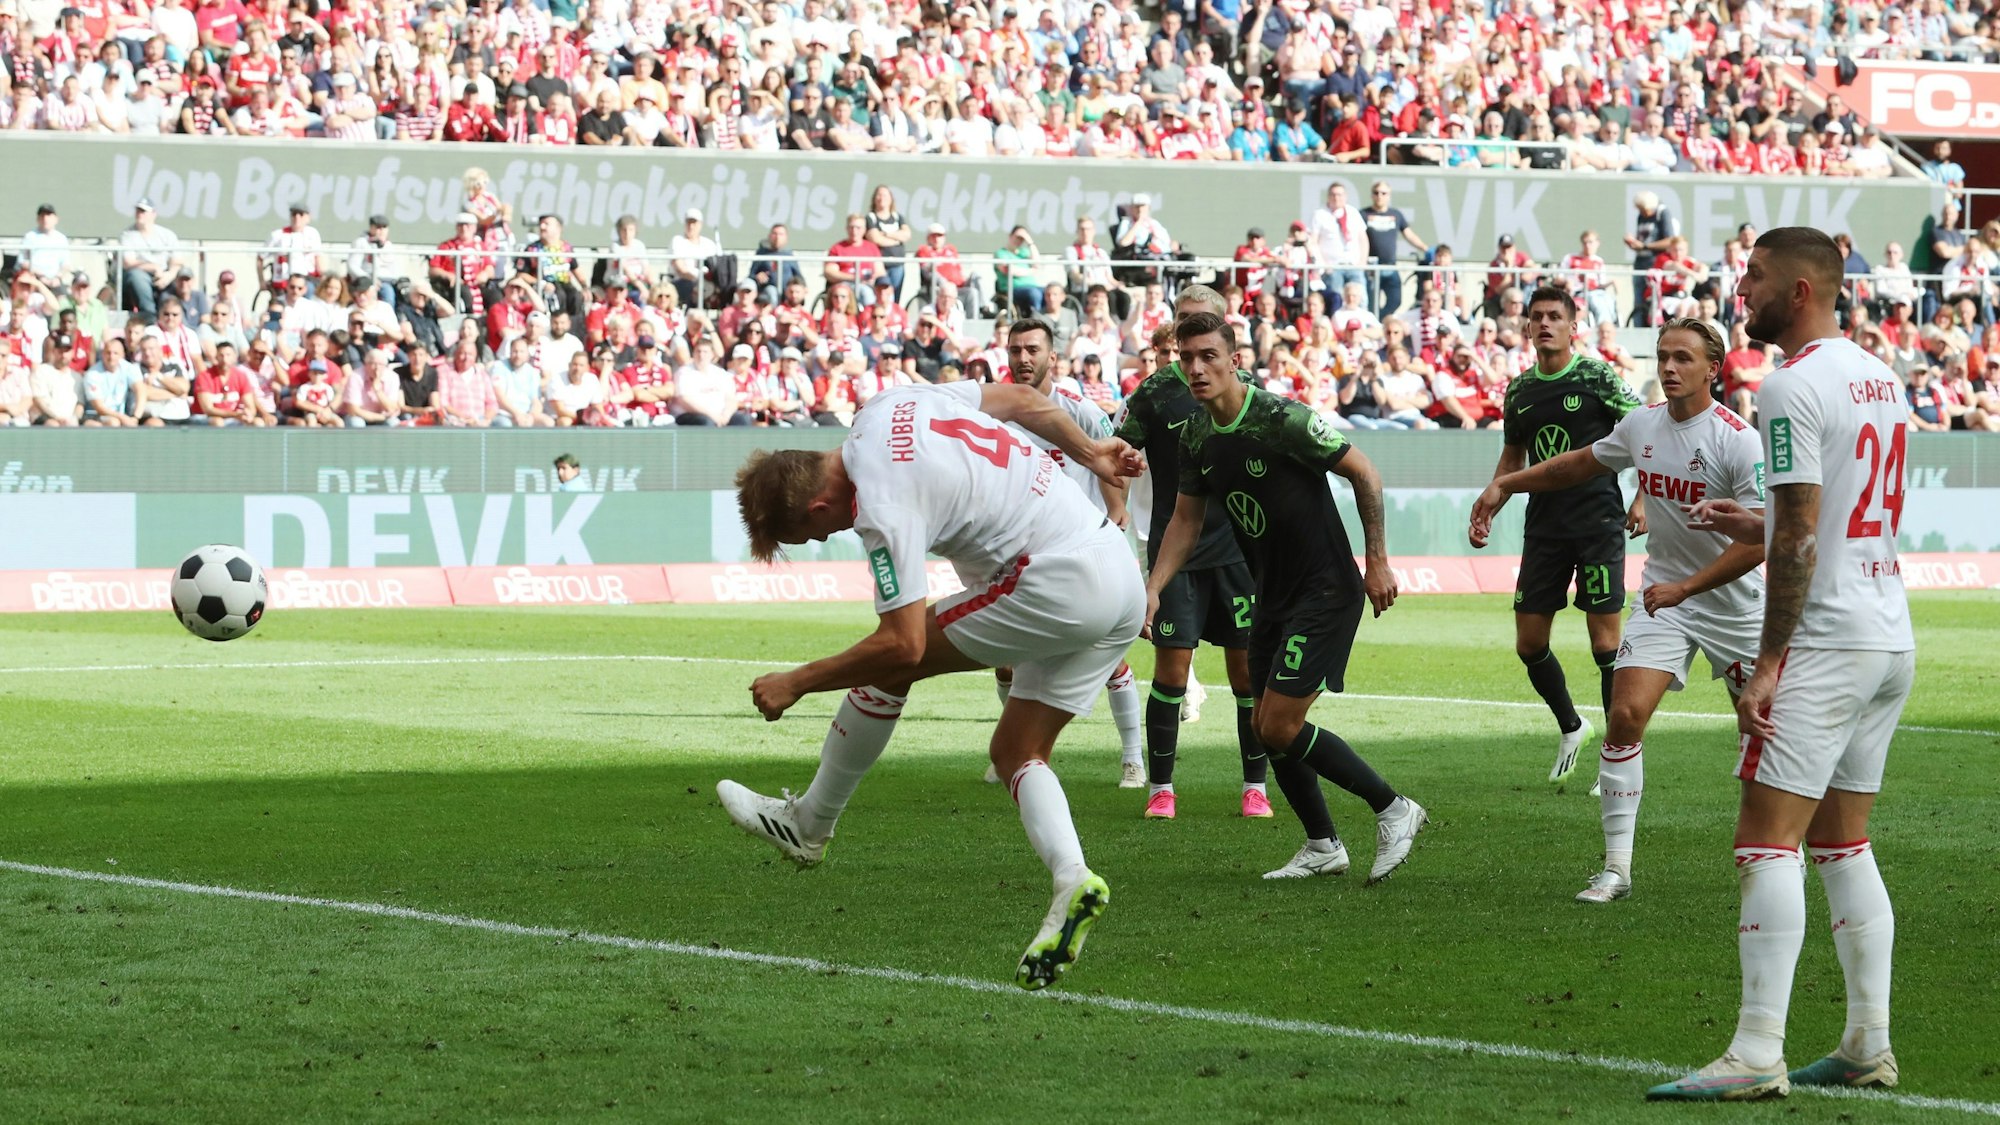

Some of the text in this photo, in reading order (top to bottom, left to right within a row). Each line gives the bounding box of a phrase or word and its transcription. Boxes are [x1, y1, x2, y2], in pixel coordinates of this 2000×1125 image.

[113, 154, 222, 219] Von
[232, 156, 750, 243] Berufsufähigkeit
[757, 166, 838, 231] bis
[886, 401, 917, 462] HÜBERS
[929, 418, 1031, 469] 4
[1774, 423, 1788, 468] DEVK
[317, 467, 450, 493] DEVK
[1638, 469, 1707, 504] REWE
[1846, 422, 1906, 538] 24
[243, 494, 604, 569] DEVK
[271, 571, 407, 608] DERTOUR
[494, 568, 626, 603] DERTOUR
[711, 566, 841, 601] DERTOUR
[874, 553, 896, 596] DEVK
[1584, 565, 1611, 594] 21
[1898, 560, 1985, 589] ERTOUR
[1284, 634, 1307, 670] 5
[1725, 660, 1755, 688] 4
[1738, 922, 1760, 932] ÖLN
[1832, 917, 1846, 932] ÖLN
